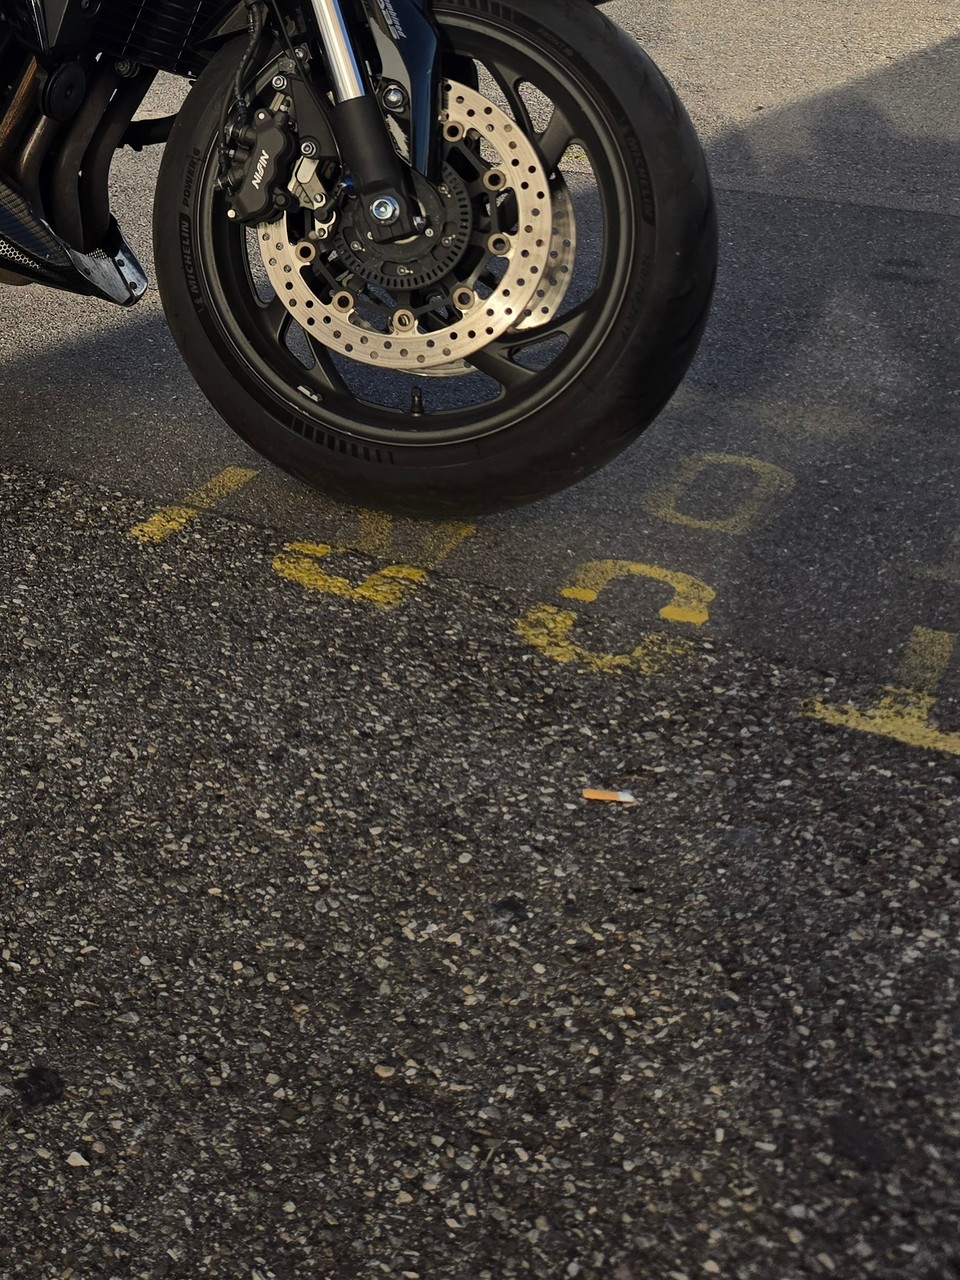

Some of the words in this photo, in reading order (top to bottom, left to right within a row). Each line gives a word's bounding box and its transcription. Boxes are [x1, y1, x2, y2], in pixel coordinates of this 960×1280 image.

[182, 159, 198, 209] POWER
[251, 149, 270, 190] NISSIN
[627, 136, 653, 218] MICHELIN
[180, 220, 200, 294] MICHELIN
